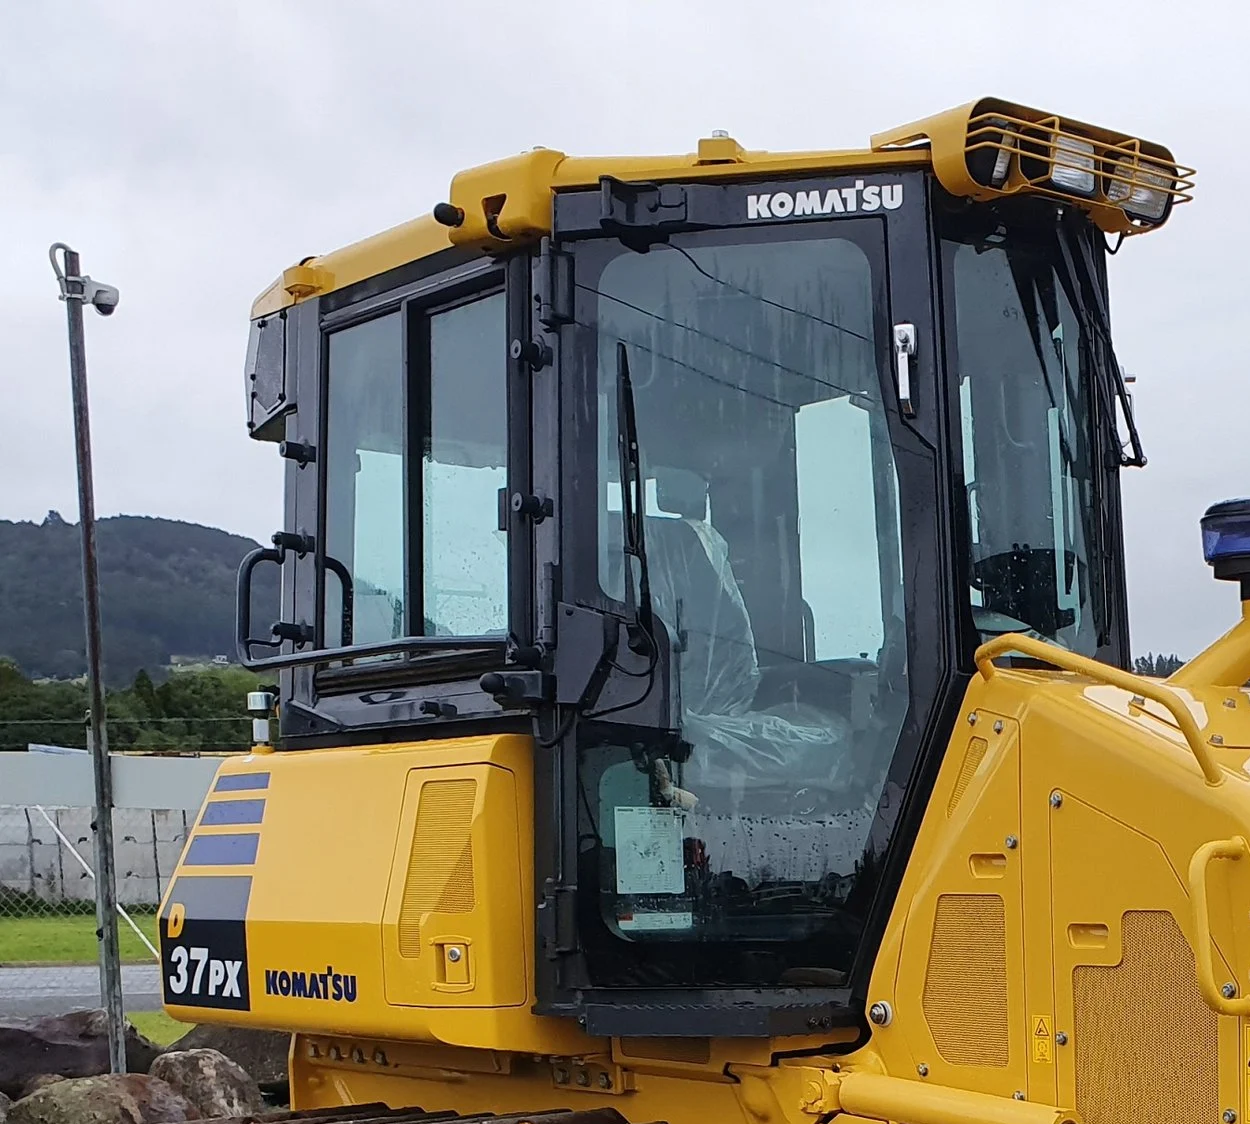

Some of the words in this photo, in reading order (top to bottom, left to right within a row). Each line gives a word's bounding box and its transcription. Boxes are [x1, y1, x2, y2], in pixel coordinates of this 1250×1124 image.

[747, 180, 904, 219] KOMATSU
[167, 903, 186, 938] D
[169, 945, 242, 998] 37PX
[265, 965, 358, 1003] KOMATSU
